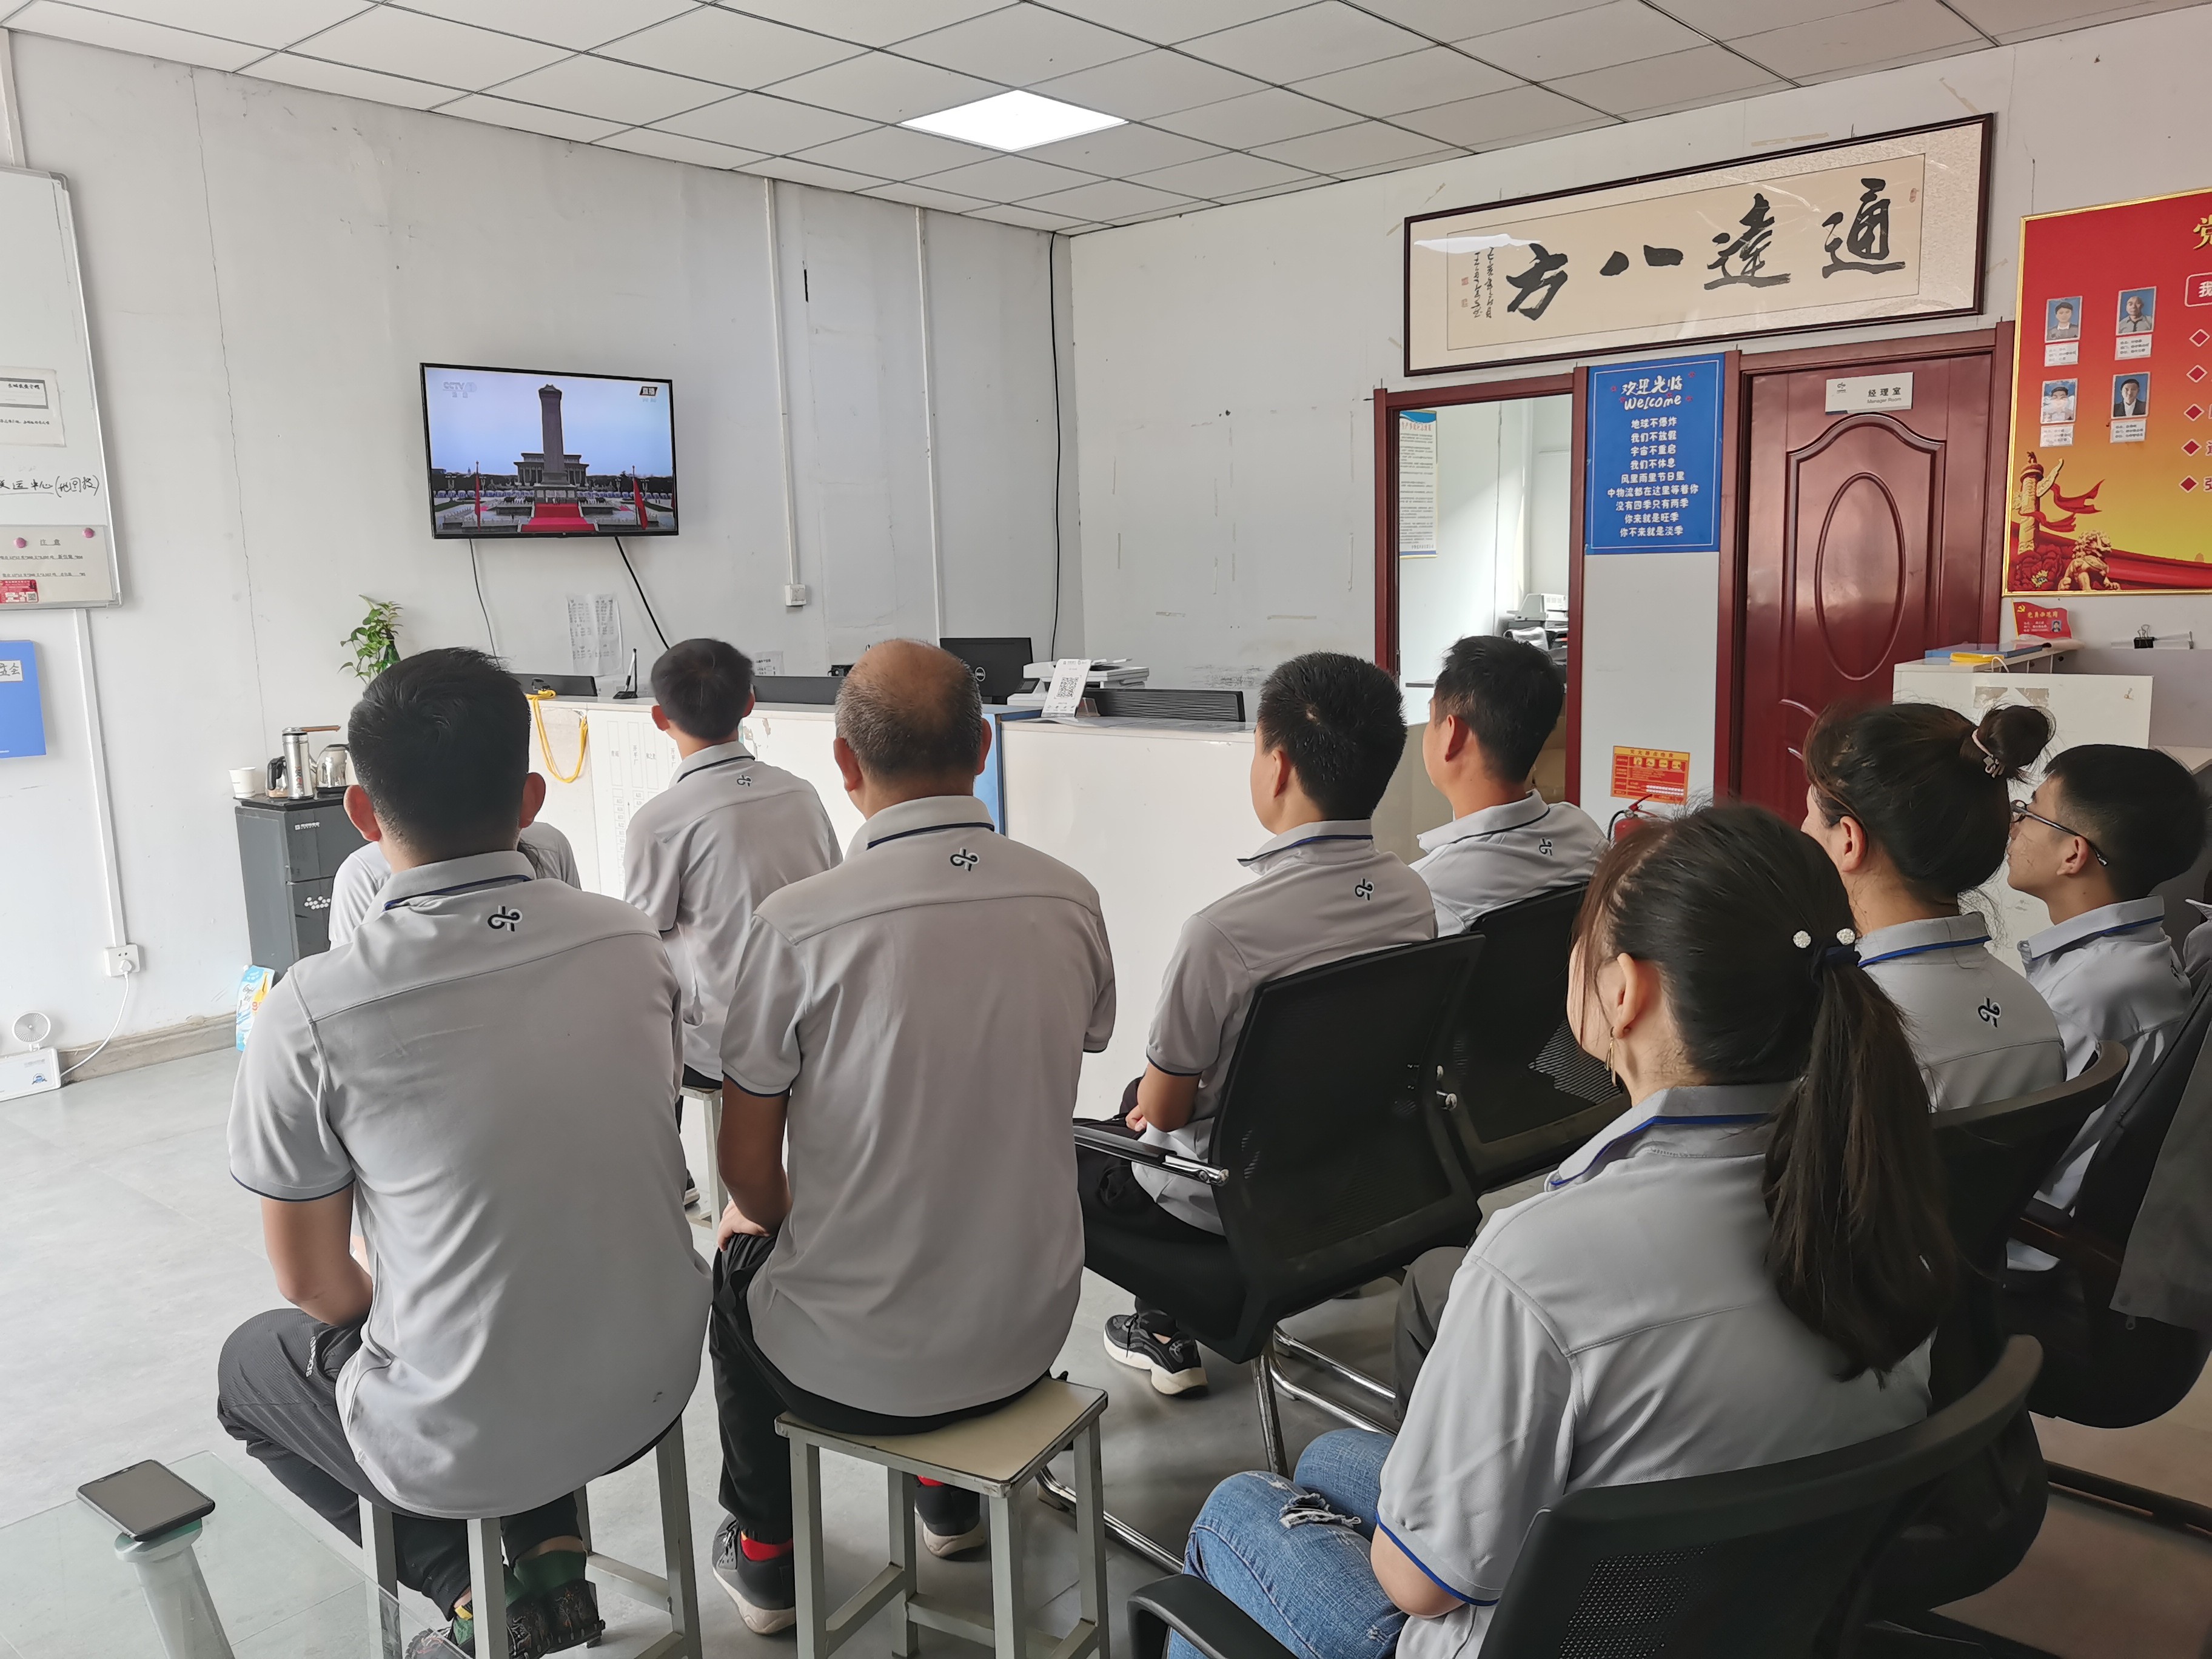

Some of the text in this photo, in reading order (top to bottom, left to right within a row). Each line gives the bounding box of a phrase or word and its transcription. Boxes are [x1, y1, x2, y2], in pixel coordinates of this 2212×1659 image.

[1621, 375, 1683, 396] 欢迎光临
[1868, 387, 1901, 397] 经理室
[1631, 416, 1678, 429] 地球不爆炸
[1631, 430, 1677, 443] 我们不放假
[1630, 443, 1677, 457] 宇宙不重启
[1630, 457, 1676, 471] 我们不休息
[1621, 471, 1685, 484] 风里雨里节日里
[1607, 483, 1699, 498] 中物流都在这里等着你
[1615, 497, 1689, 511] 没有四季只有两季
[1624, 511, 1679, 524] 你来就是旺季
[1620, 525, 1684, 538] 你不来就是淡季
